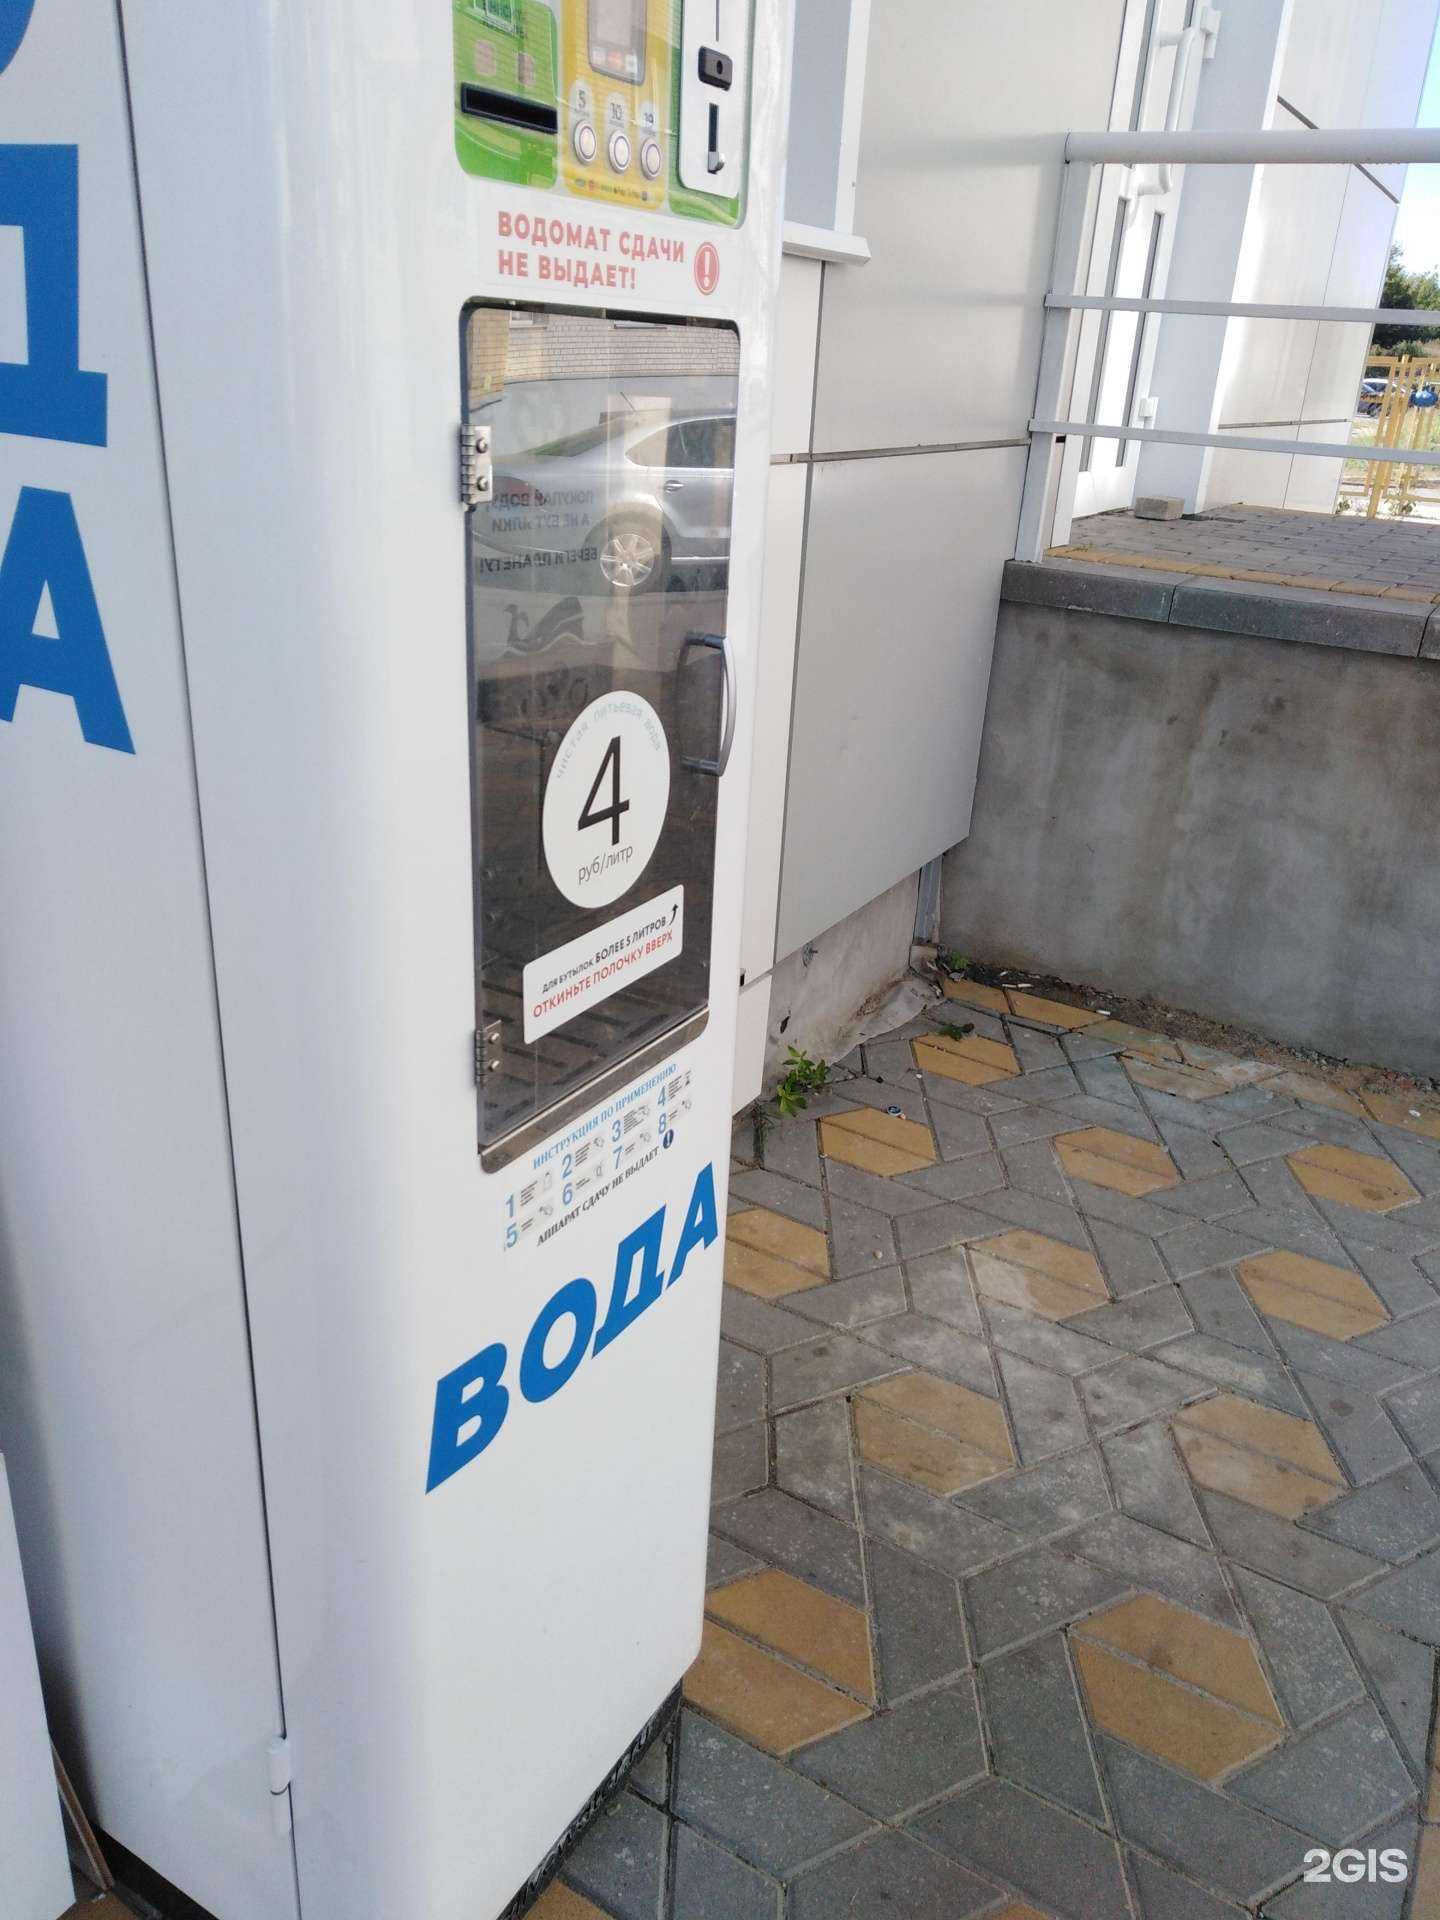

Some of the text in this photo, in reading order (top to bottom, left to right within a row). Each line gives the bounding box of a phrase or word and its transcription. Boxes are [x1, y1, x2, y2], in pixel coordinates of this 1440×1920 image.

[498, 211, 685, 263] ВОДОМАТ СДАЧИ
[498, 249, 636, 290] НЕ ВЫДАЕТ!
[0, 0, 135, 756] ДА
[578, 735, 630, 846] 4
[578, 845, 633, 886] руб/литр
[533, 930, 673, 1018] ОТКИНЬТЕ ПОЛОЧКУ ВВЕРХ
[542, 916, 667, 995] ДЛЯ БУТЫЛОК БОЛЕЕ 5 ЛИТРОВ
[506, 1194, 514, 1218] 1
[562, 1153, 573, 1179] 2
[611, 1119, 621, 1143] 3
[657, 1085, 666, 1107] 4
[533, 1118, 600, 1170] ИНСТРУКЦИЯ
[601, 1107, 614, 1124] ПО
[615, 1063, 677, 1111] ПРИМЕНЕНИЮ
[507, 1223, 518, 1248] 5
[562, 1182, 573, 1206] 6
[613, 1146, 623, 1170] 7
[658, 1112, 667, 1135] 8
[537, 1205, 581, 1247] АППАРАТ
[582, 1184, 611, 1212] СДАЧУ
[612, 1173, 624, 1189] НЕ
[625, 1145, 660, 1179] ВЫДАЕТ
[426, 1161, 719, 1495] ВОДА
